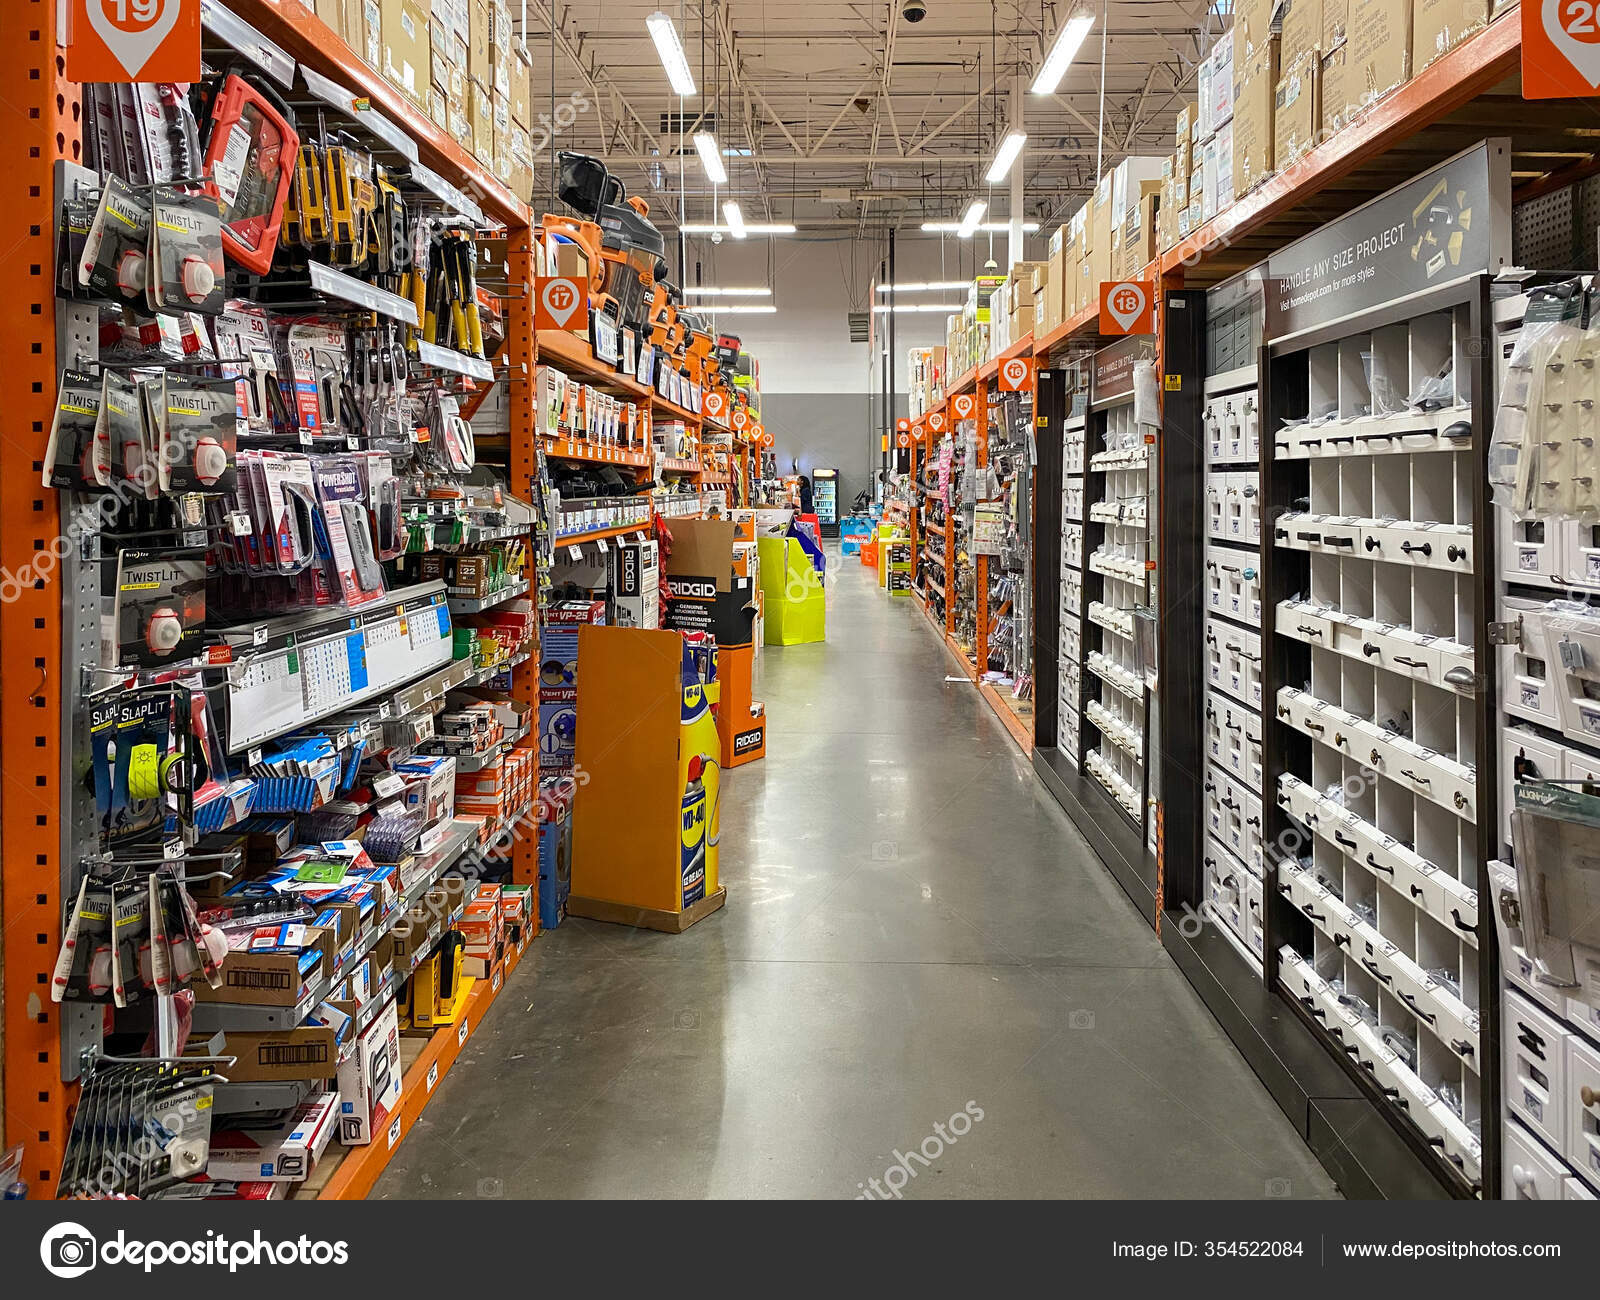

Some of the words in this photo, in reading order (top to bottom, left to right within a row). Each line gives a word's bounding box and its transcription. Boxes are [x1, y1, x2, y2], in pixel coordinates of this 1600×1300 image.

[111, 0, 157, 22] 19
[1567, 1, 1600, 33] 2
[111, 195, 149, 230] TWISTLI
[1279, 266, 1311, 294] HANDLE
[1313, 260, 1331, 280] ANY
[1332, 248, 1354, 272] SIZE
[1356, 223, 1406, 261] PROJECT
[1279, 297, 1291, 312] Visit
[1290, 283, 1333, 309] homedepot.com
[1332, 280, 1341, 294] for
[1340, 274, 1357, 291] more
[1356, 264, 1376, 287] styles
[551, 293, 570, 306] 17
[1116, 297, 1137, 311] 18
[217, 315, 237, 325] ARROW
[251, 319, 264, 332] 50
[327, 333, 341, 344] 50
[1009, 368, 1022, 377] 16
[66, 391, 99, 410] TWIST
[959, 401, 969, 409] 14
[266, 463, 287, 472] ARROW
[625, 550, 636, 592] RIDGID
[669, 582, 716, 597] RIDGID
[559, 611, 588, 621] VP-25
[209, 649, 231, 660] new!
[686, 687, 700, 699] WD-40
[736, 731, 761, 748] RIDGID
[683, 802, 705, 831] WD-40
[84, 897, 111, 913] TWIST
[155, 1101, 169, 1112] LED
